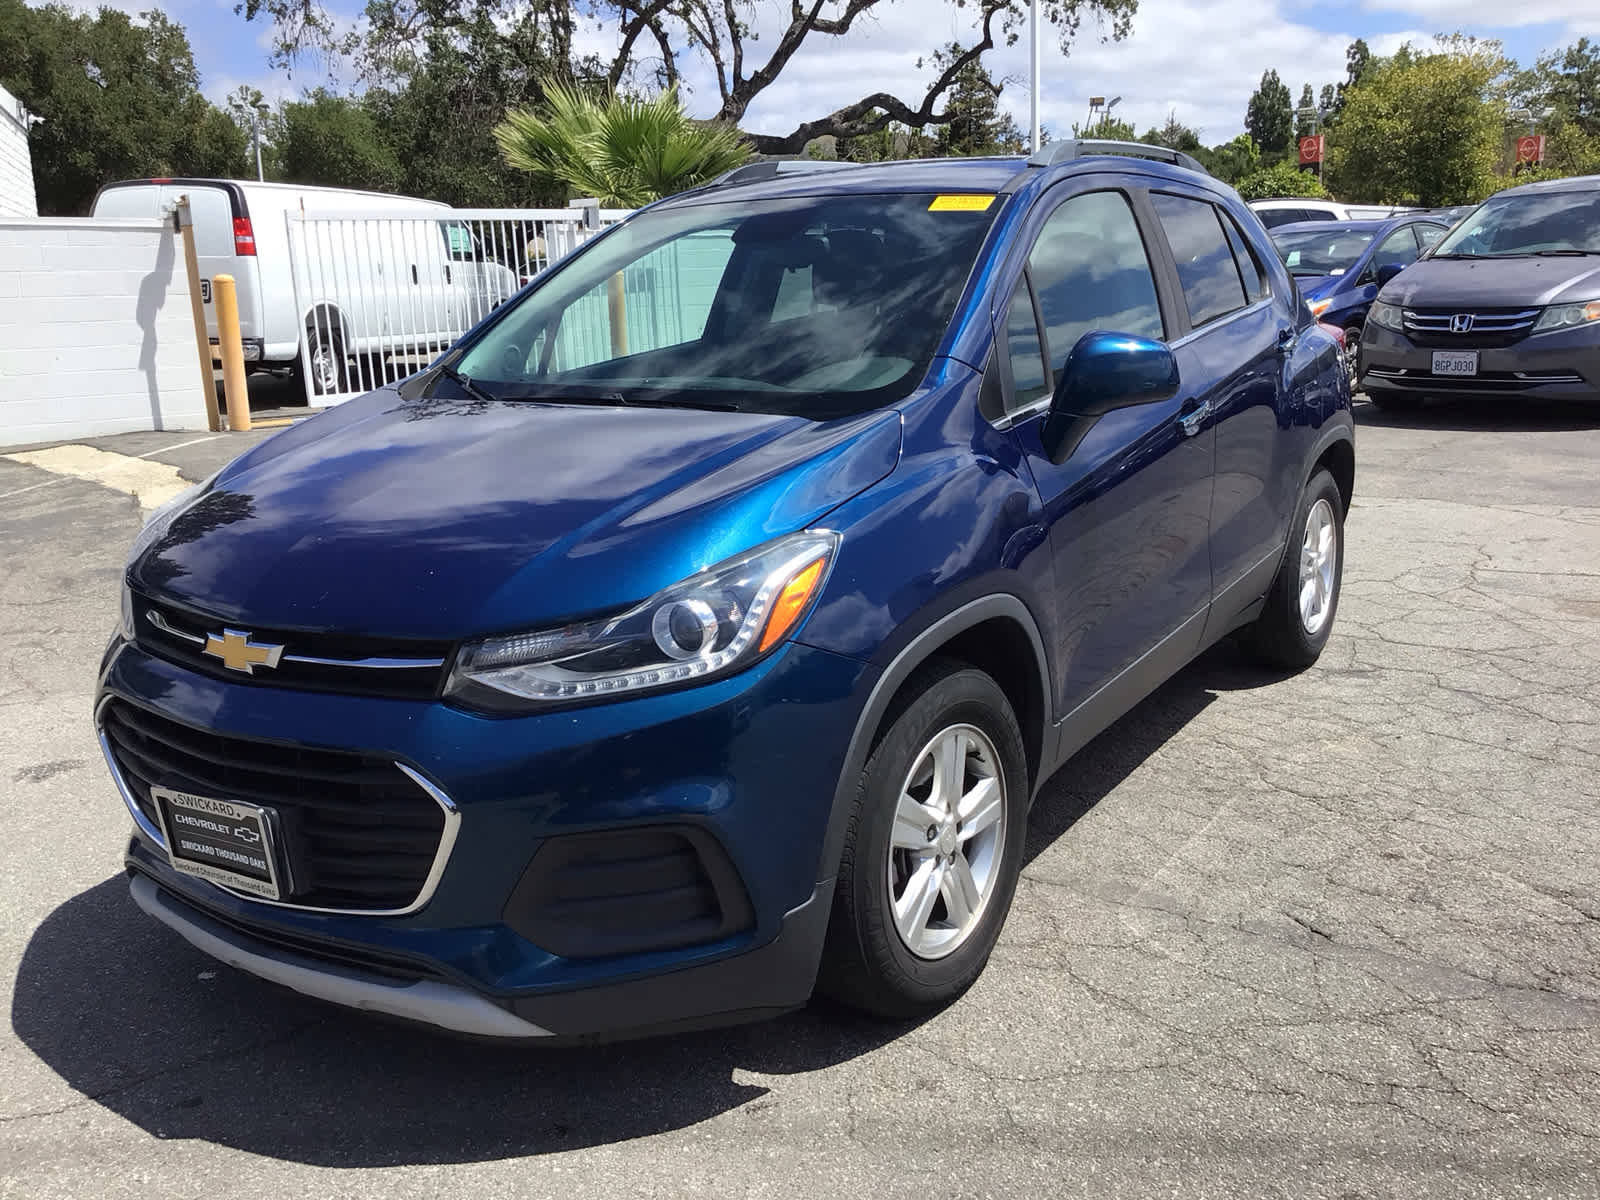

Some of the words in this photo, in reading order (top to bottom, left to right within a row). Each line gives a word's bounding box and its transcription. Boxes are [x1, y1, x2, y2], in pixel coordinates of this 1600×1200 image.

[1434, 360, 1474, 372] 8GPJ030
[177, 795, 234, 815] SWICKARD
[175, 814, 231, 834] CHEVROLET
[181, 840, 214, 855] SWICKARD
[215, 848, 249, 864] THOUSAND
[249, 857, 266, 870] OAKS
